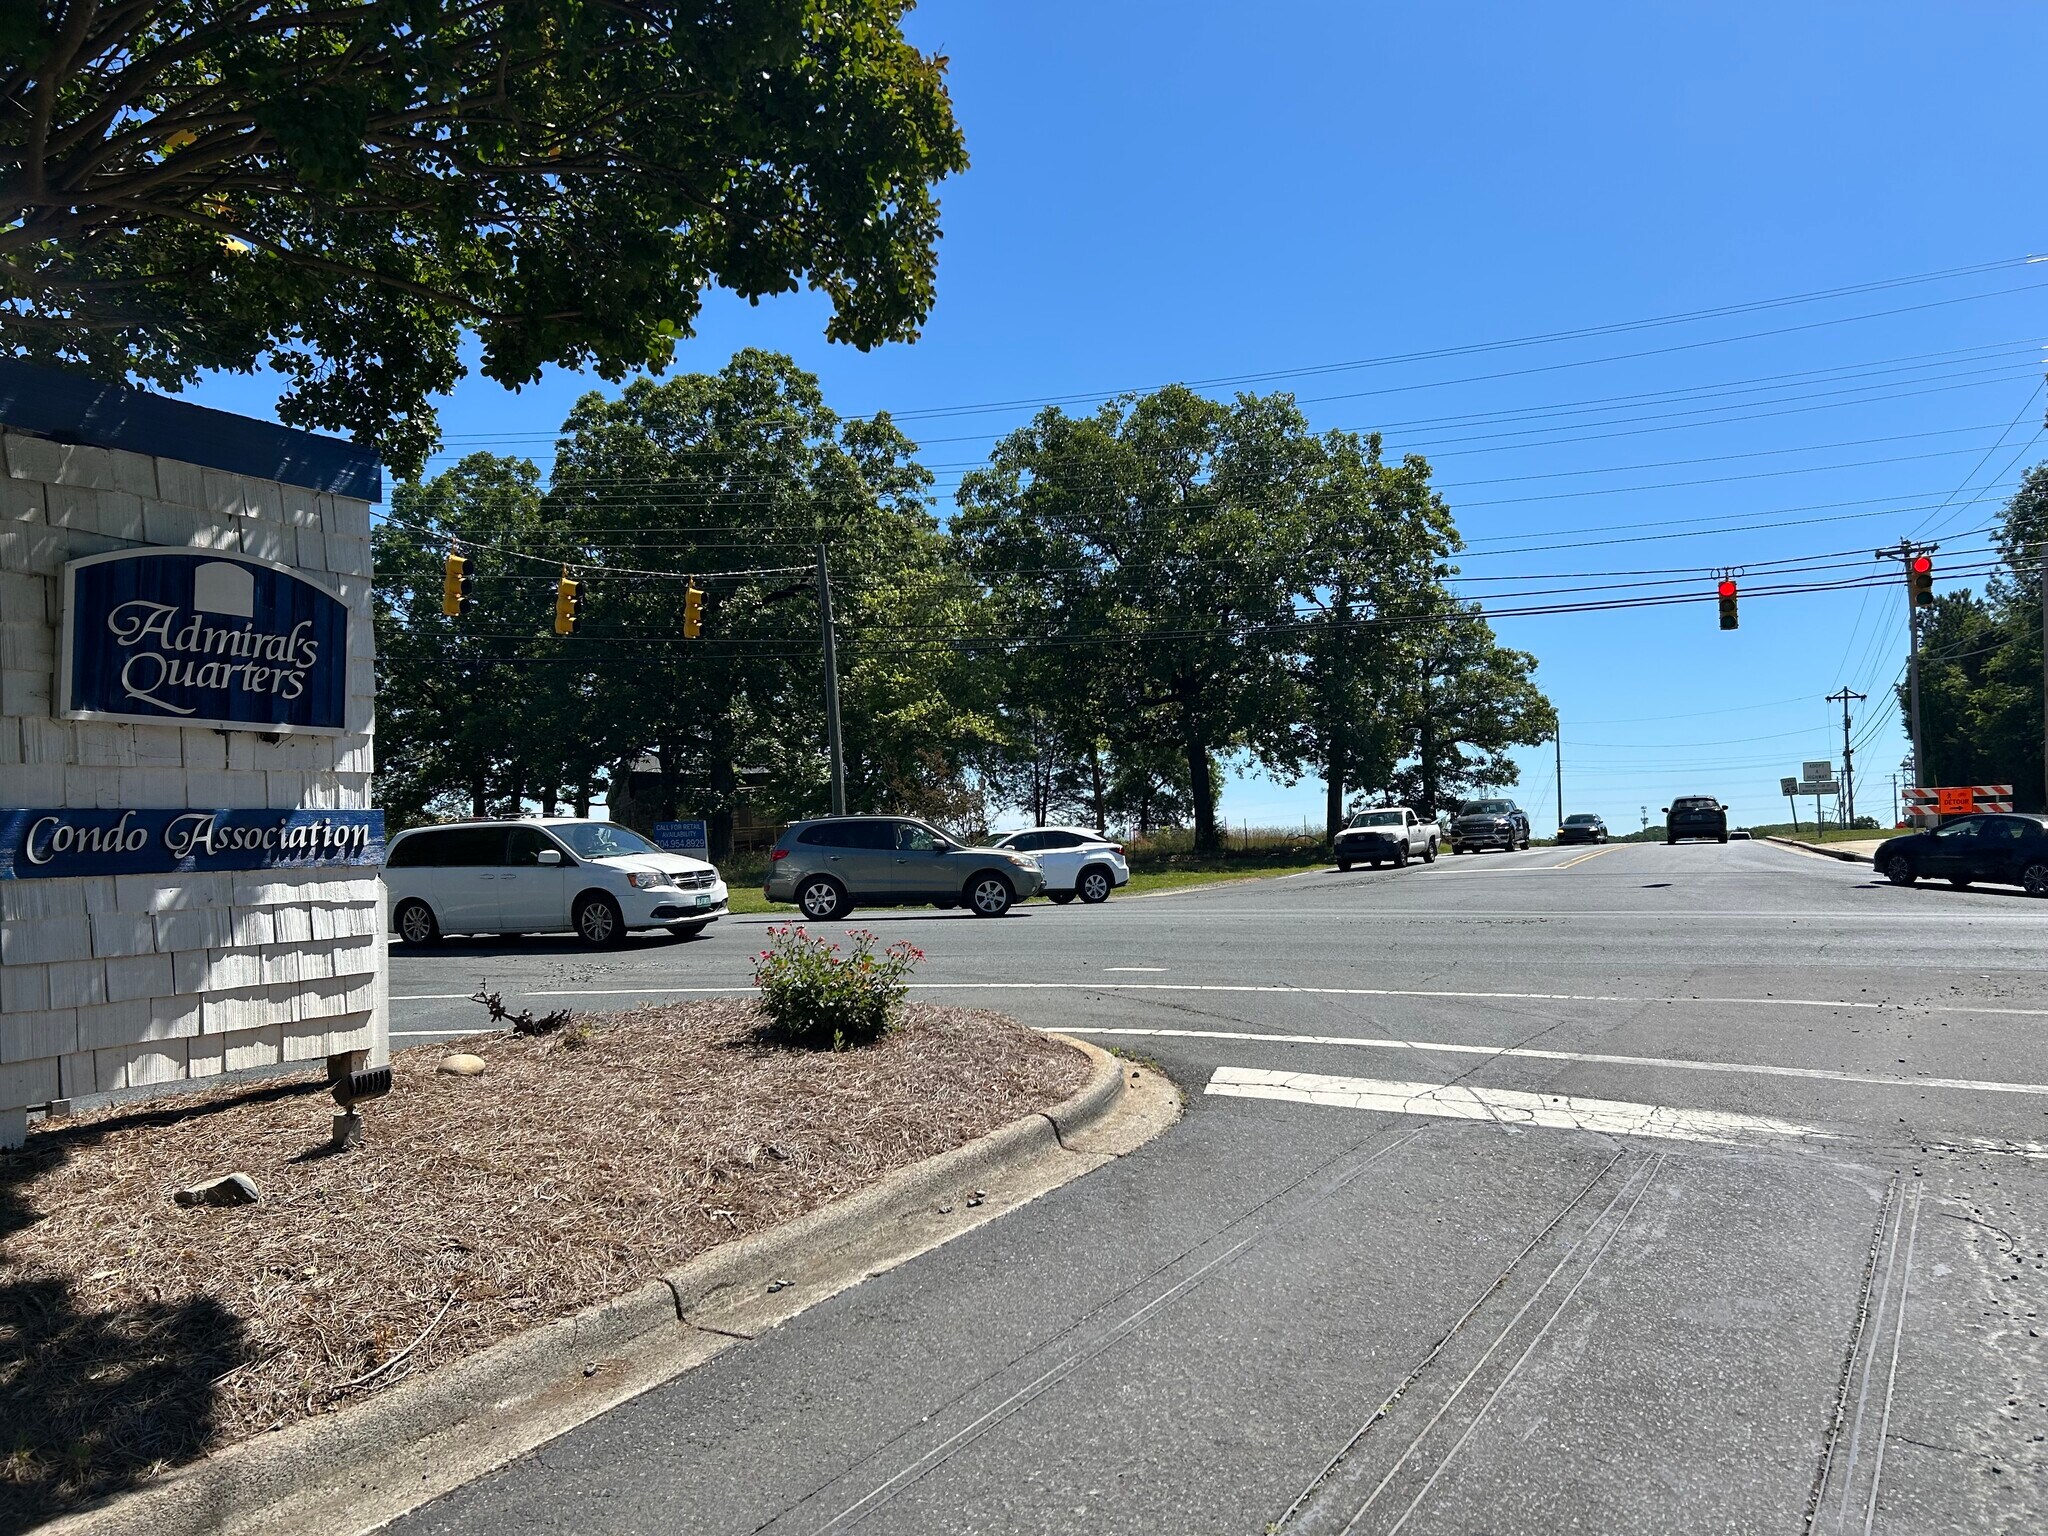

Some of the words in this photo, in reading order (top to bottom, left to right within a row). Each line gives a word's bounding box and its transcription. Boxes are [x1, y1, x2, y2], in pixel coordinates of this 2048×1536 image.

[107, 599, 319, 669] Admiral's
[121, 651, 306, 715] Quarters
[26, 810, 148, 865] Condo
[164, 813, 372, 859] Association
